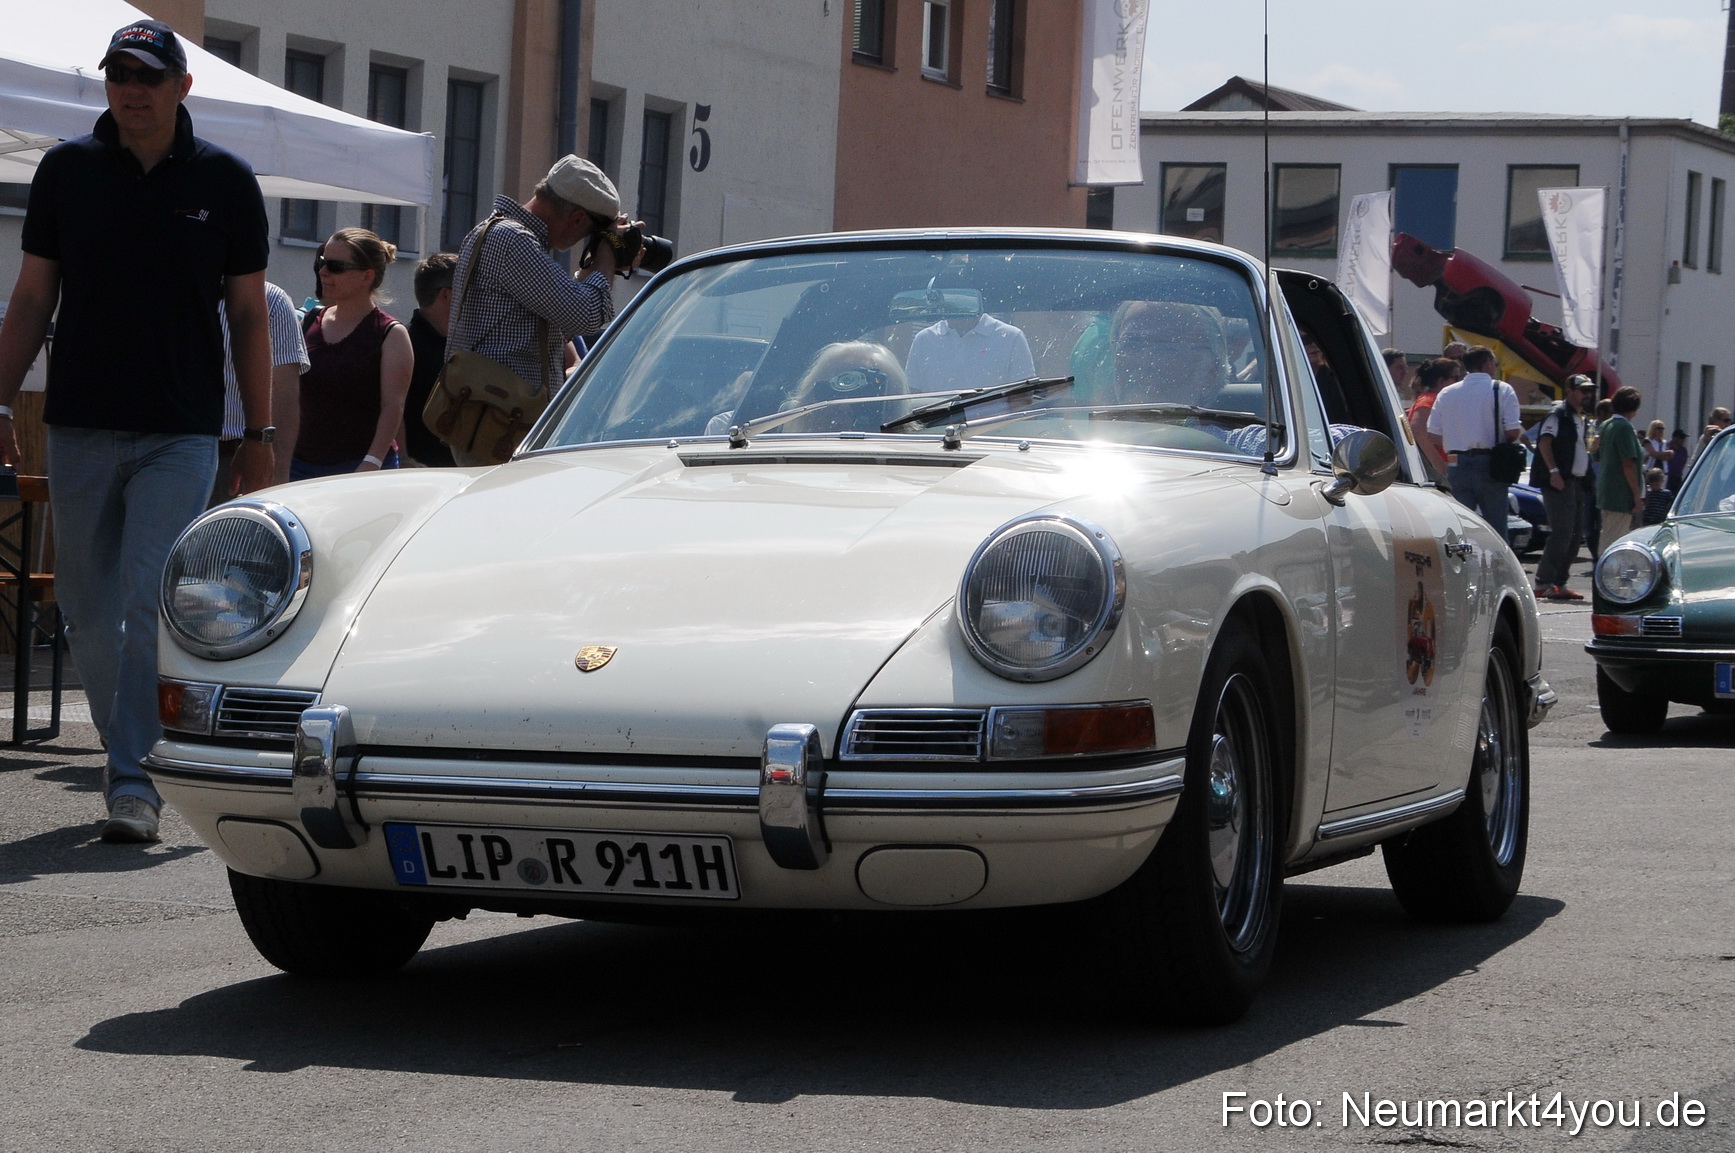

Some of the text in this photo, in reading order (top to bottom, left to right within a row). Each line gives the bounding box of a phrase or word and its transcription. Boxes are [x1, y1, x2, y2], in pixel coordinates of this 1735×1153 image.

[1111, 22, 1131, 150] OFENWERK
[690, 102, 711, 172] 5
[1129, 101, 1138, 150] ZENTRUM
[403, 860, 415, 873] D
[421, 832, 729, 891] LIP R 911H
